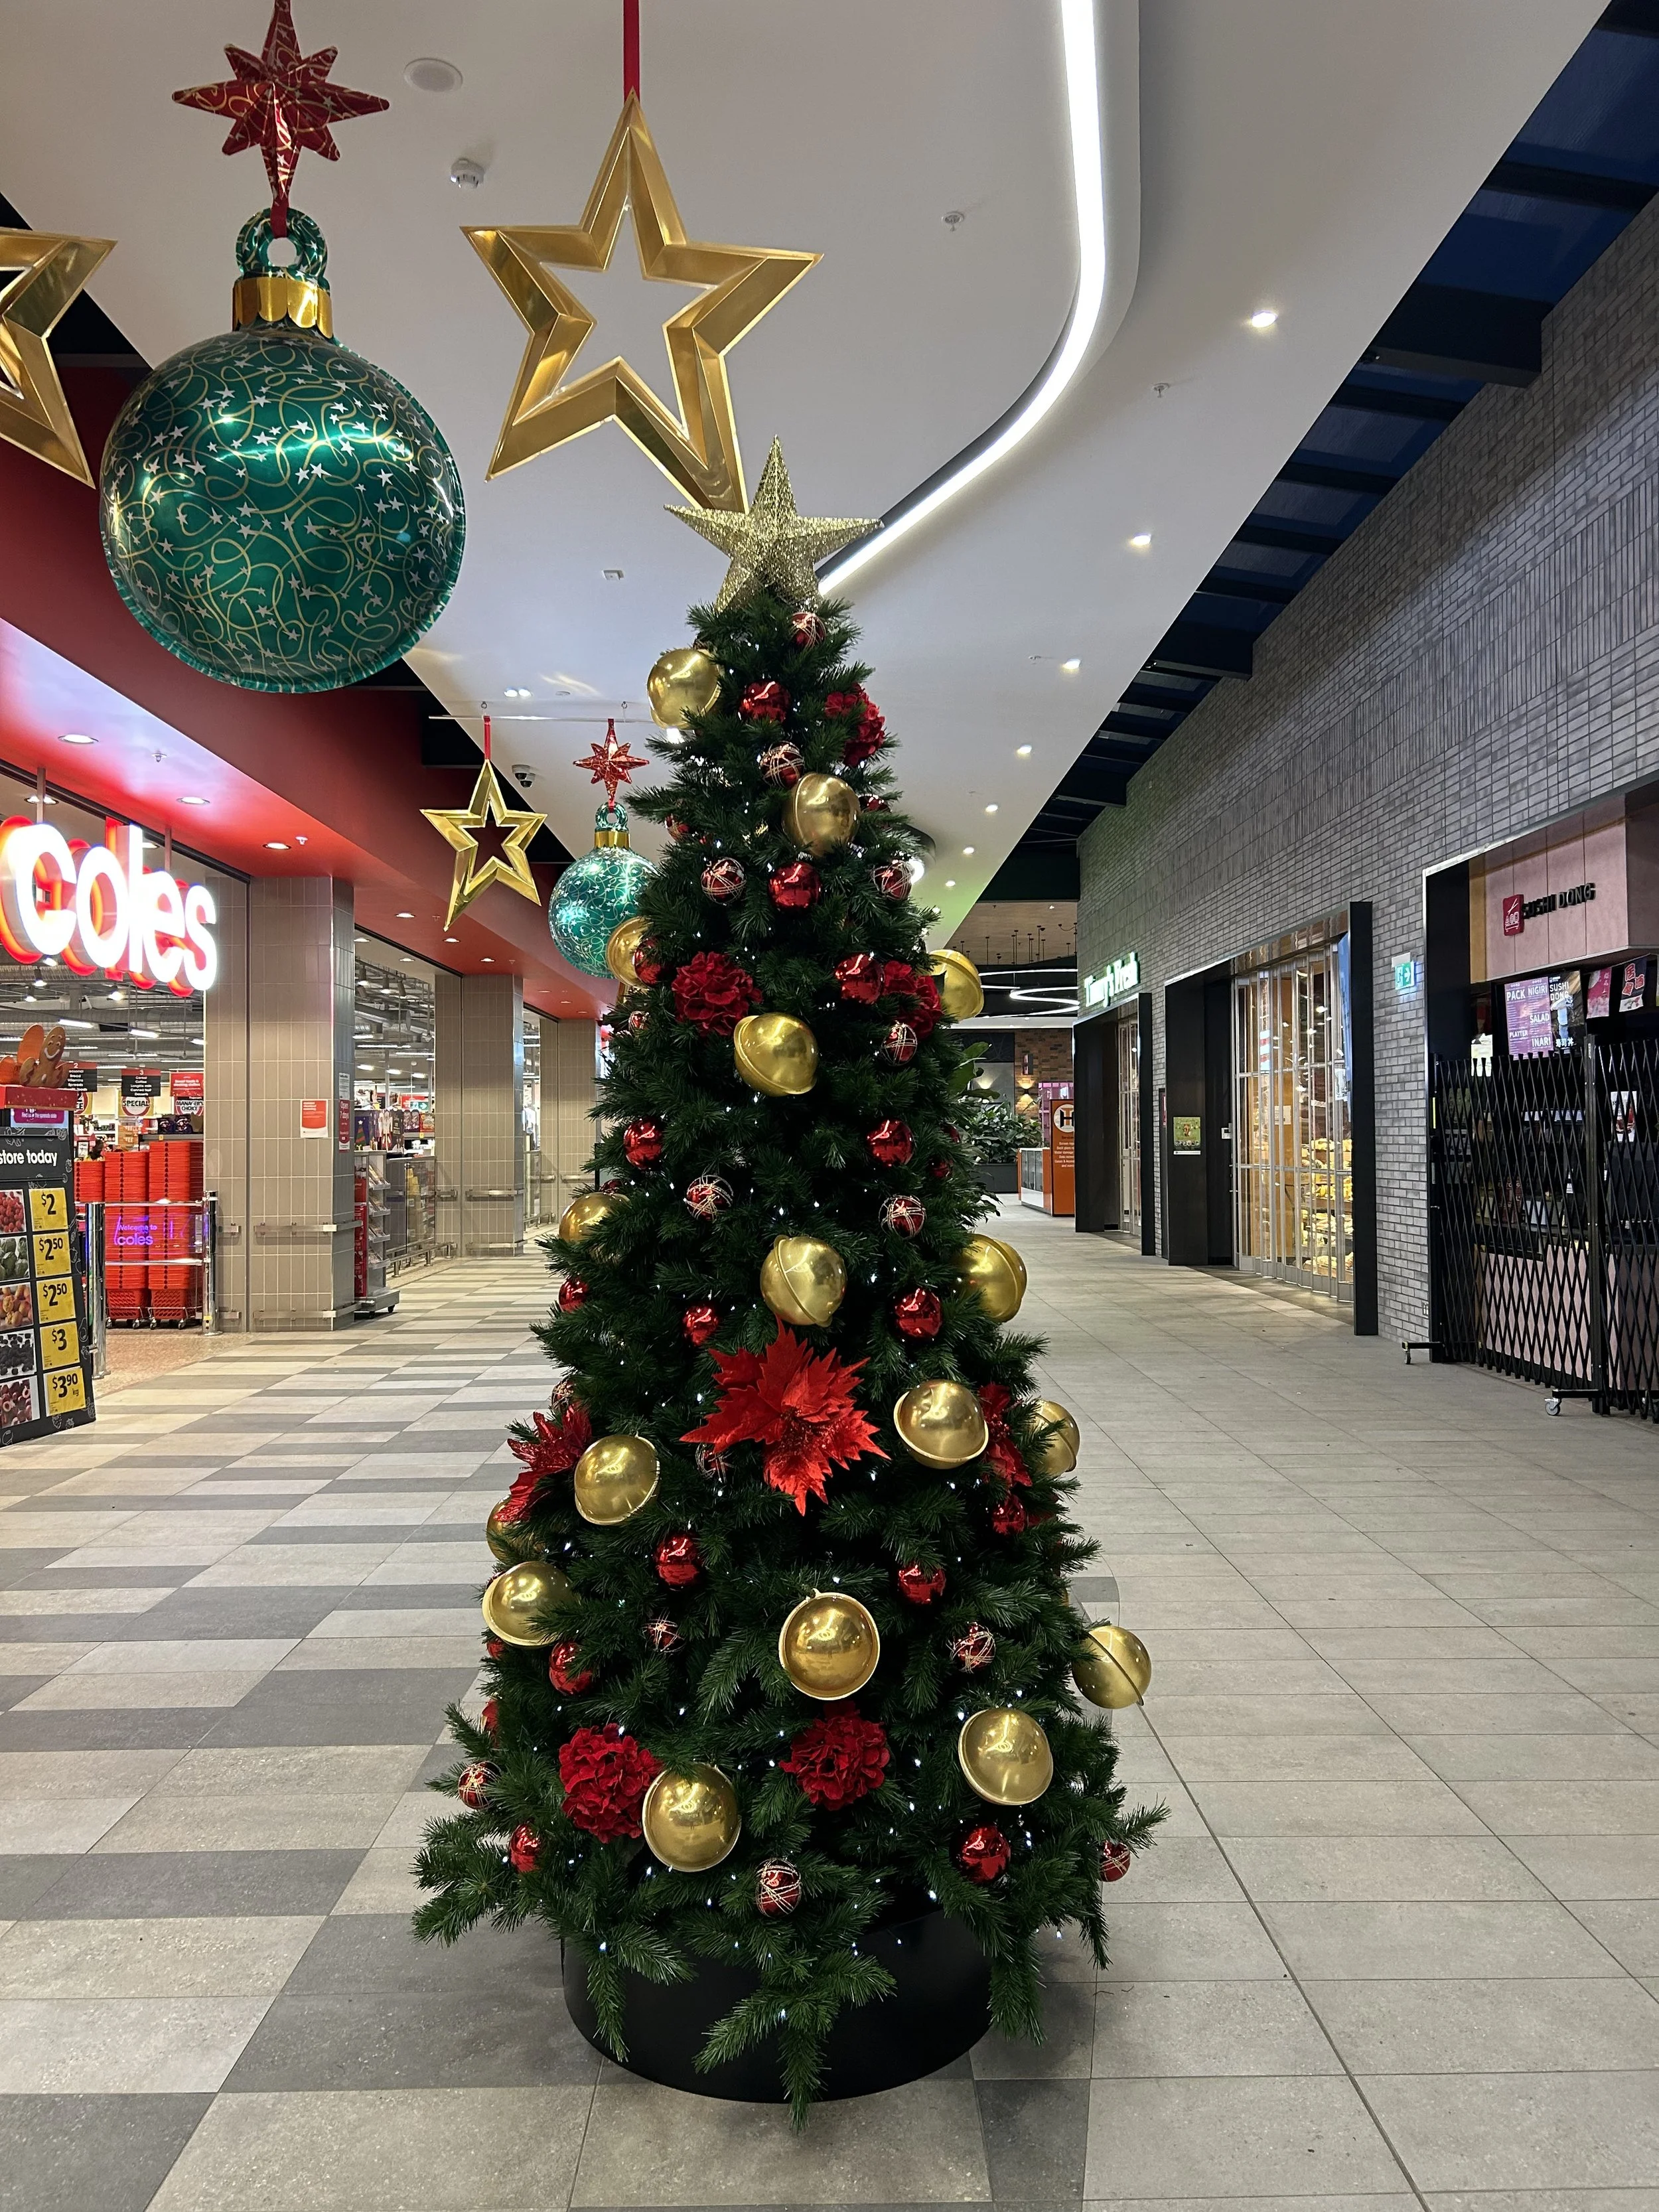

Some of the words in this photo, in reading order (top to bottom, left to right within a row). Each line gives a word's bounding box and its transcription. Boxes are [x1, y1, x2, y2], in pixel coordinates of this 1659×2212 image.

[1558, 883, 1595, 909] DONG
[4, 822, 218, 992] coles
[1528, 984, 1548, 996] NIGIRI
[1550, 982, 1569, 992] SUSHI
[1506, 989, 1526, 1001] PACK
[1550, 991, 1569, 1001] DONG
[1530, 1013, 1550, 1023] SALAD
[1509, 1029, 1528, 1038] PLATTER
[1532, 1036, 1551, 1047] INARI
[26, 1149, 58, 1167] today
[41, 1192, 57, 1215] $2
[117, 1233, 154, 1246] coles
[52, 1328, 68, 1351] $3
[72, 1388, 79, 1396] kg
